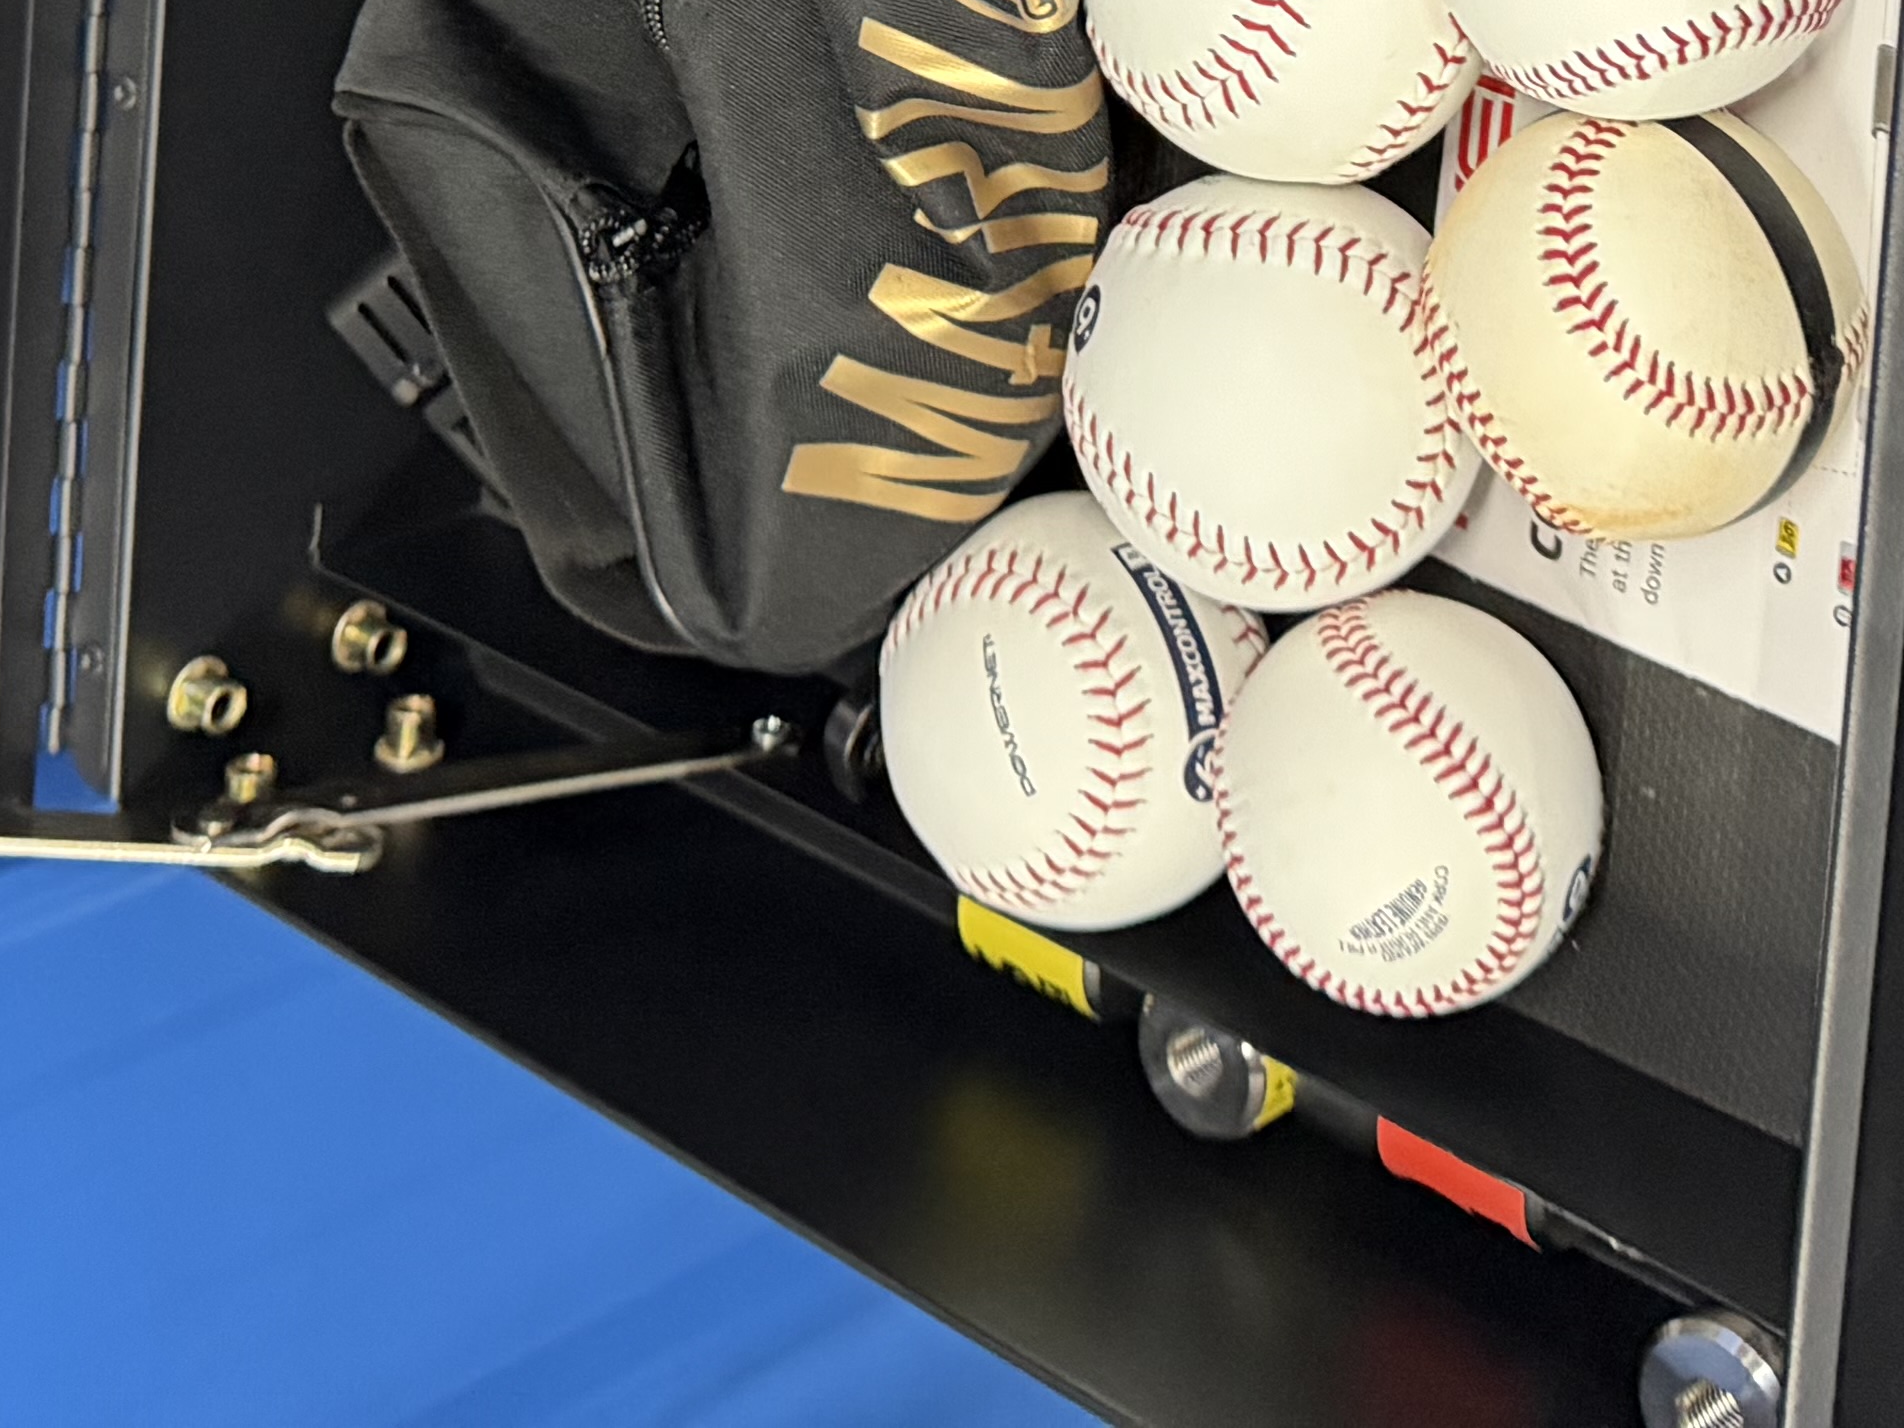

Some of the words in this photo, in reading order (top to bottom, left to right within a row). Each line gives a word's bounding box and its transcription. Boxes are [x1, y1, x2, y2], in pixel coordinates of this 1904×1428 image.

[1612, 566, 1628, 594] at
[1641, 543, 1666, 606] down
[1142, 564, 1217, 727] MAXCONTROL
